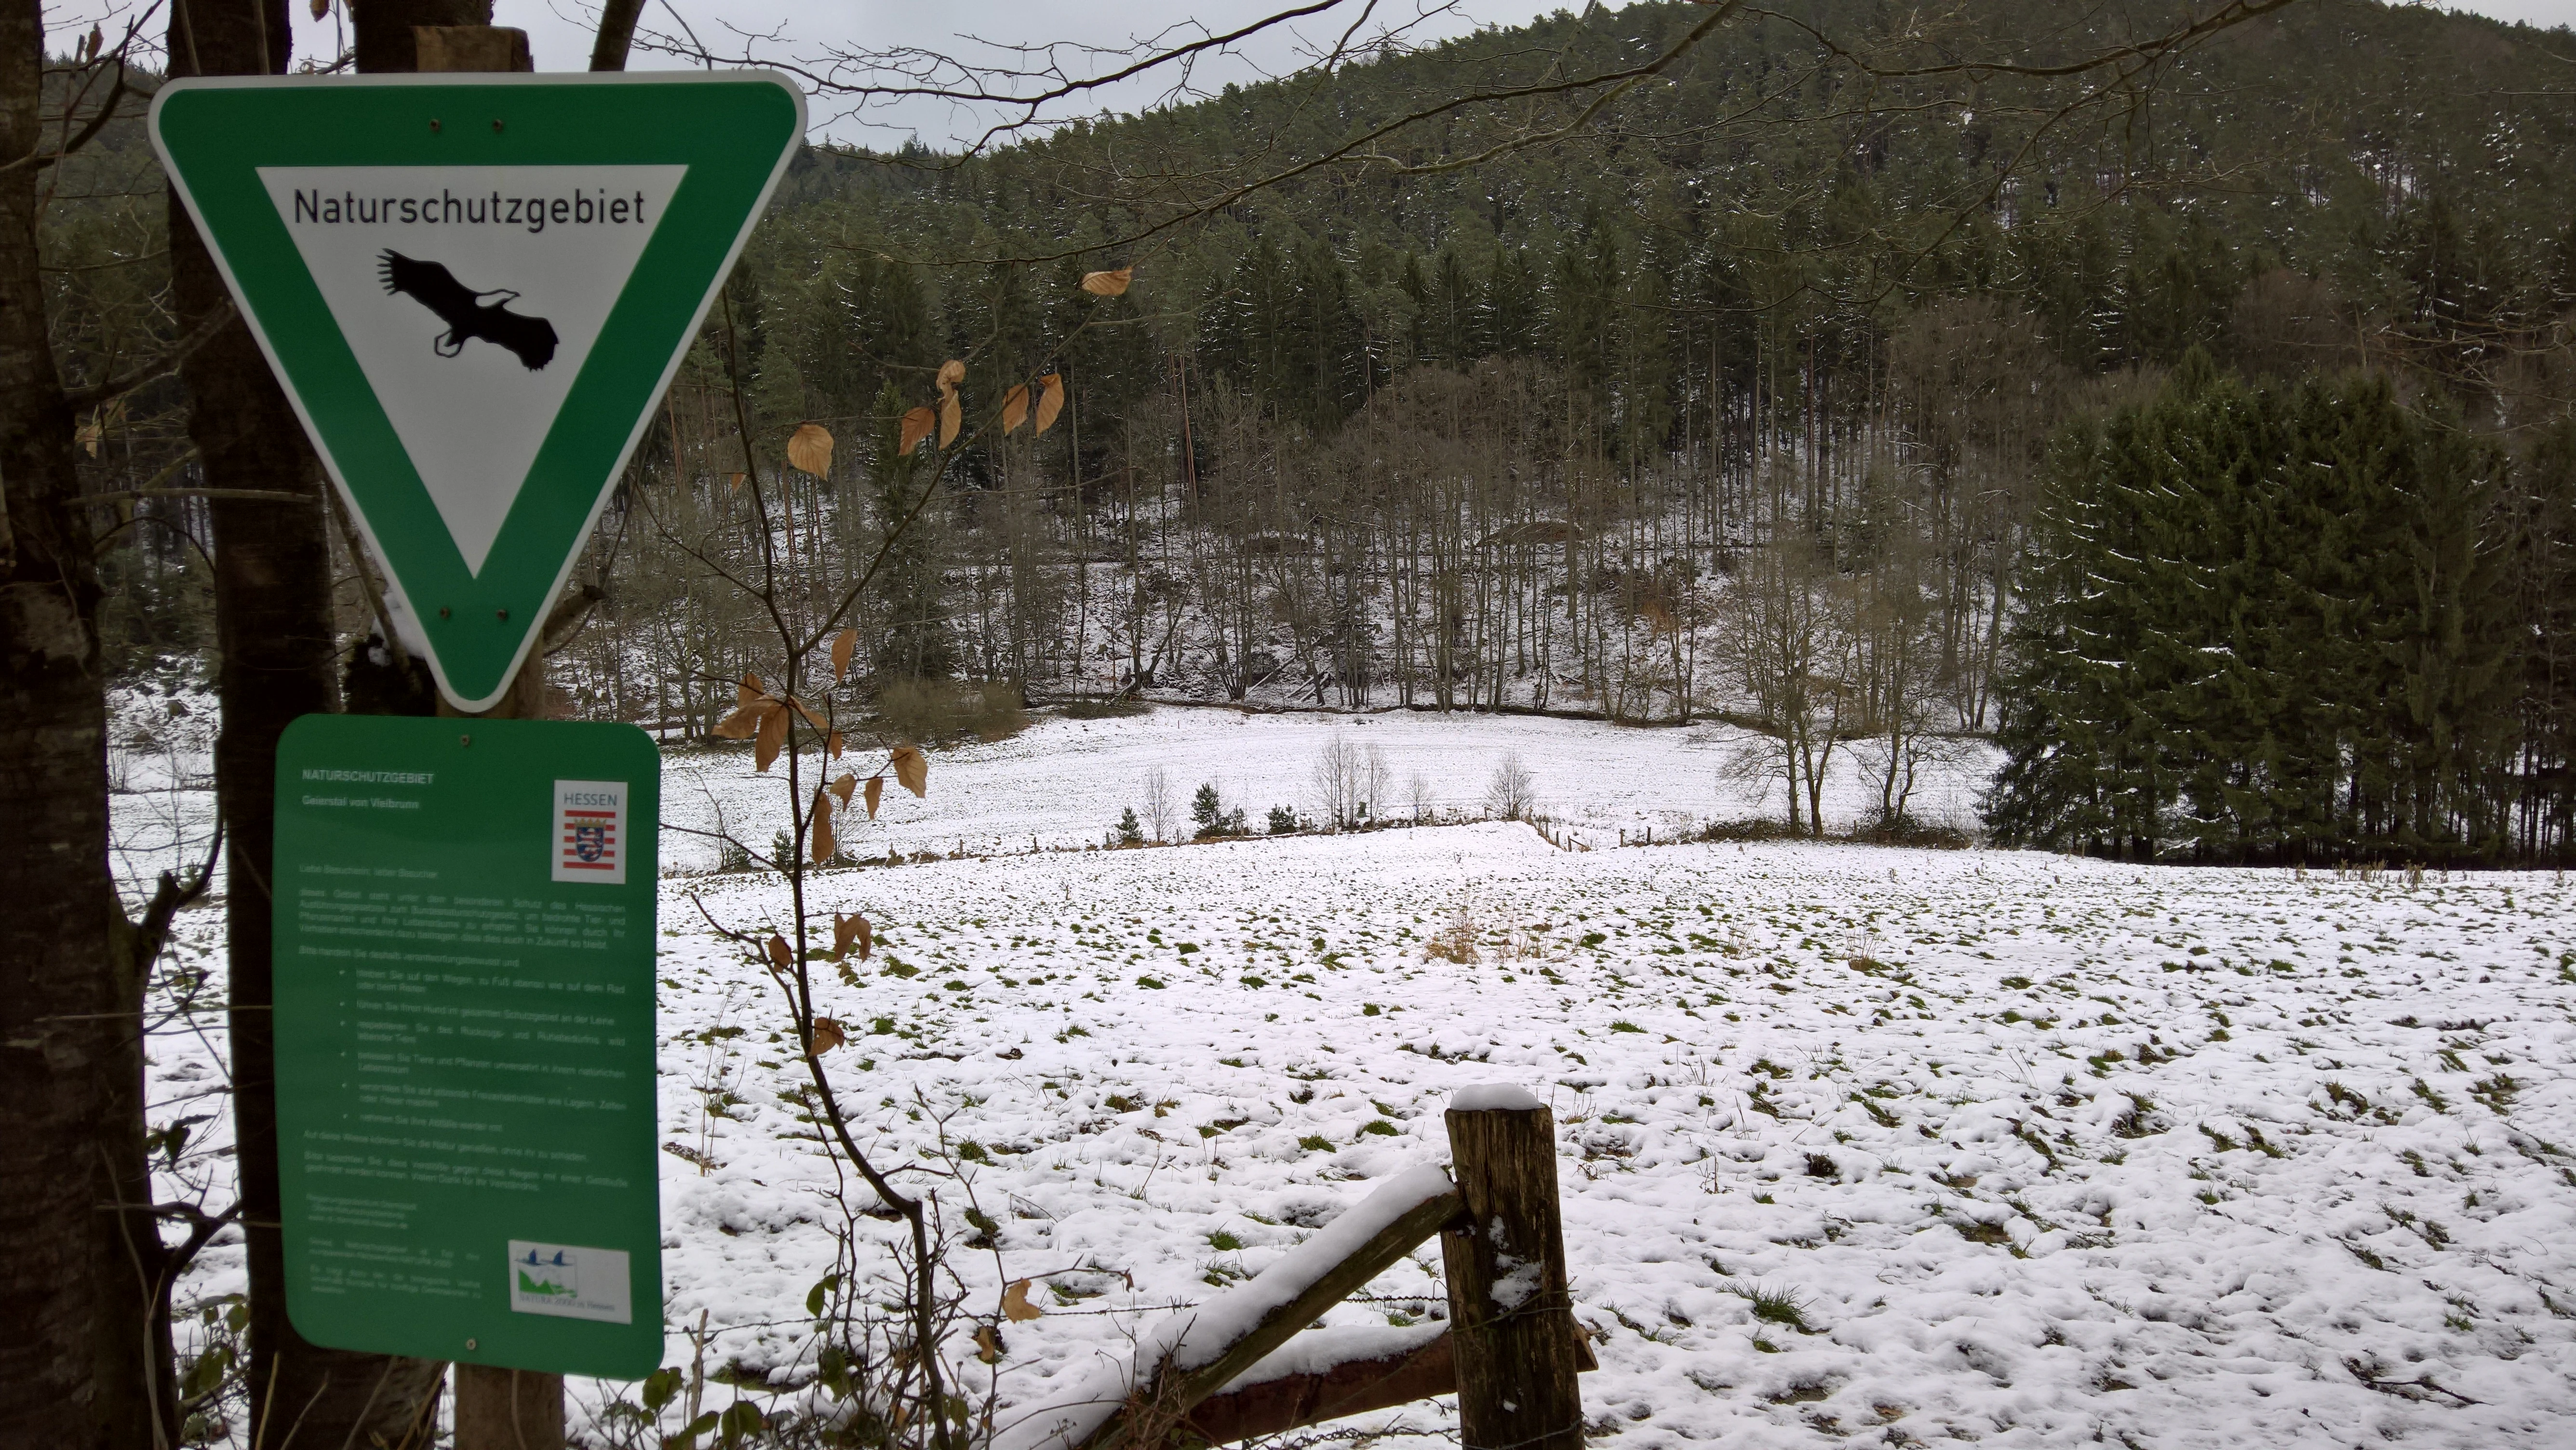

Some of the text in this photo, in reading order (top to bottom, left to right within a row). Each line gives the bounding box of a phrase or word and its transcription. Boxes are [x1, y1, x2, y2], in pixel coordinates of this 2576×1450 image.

[294, 188, 645, 233] Naturschutzgebiet
[302, 769, 434, 784] NATURSCHUTZGEBIET
[564, 793, 618, 807] HESSEN
